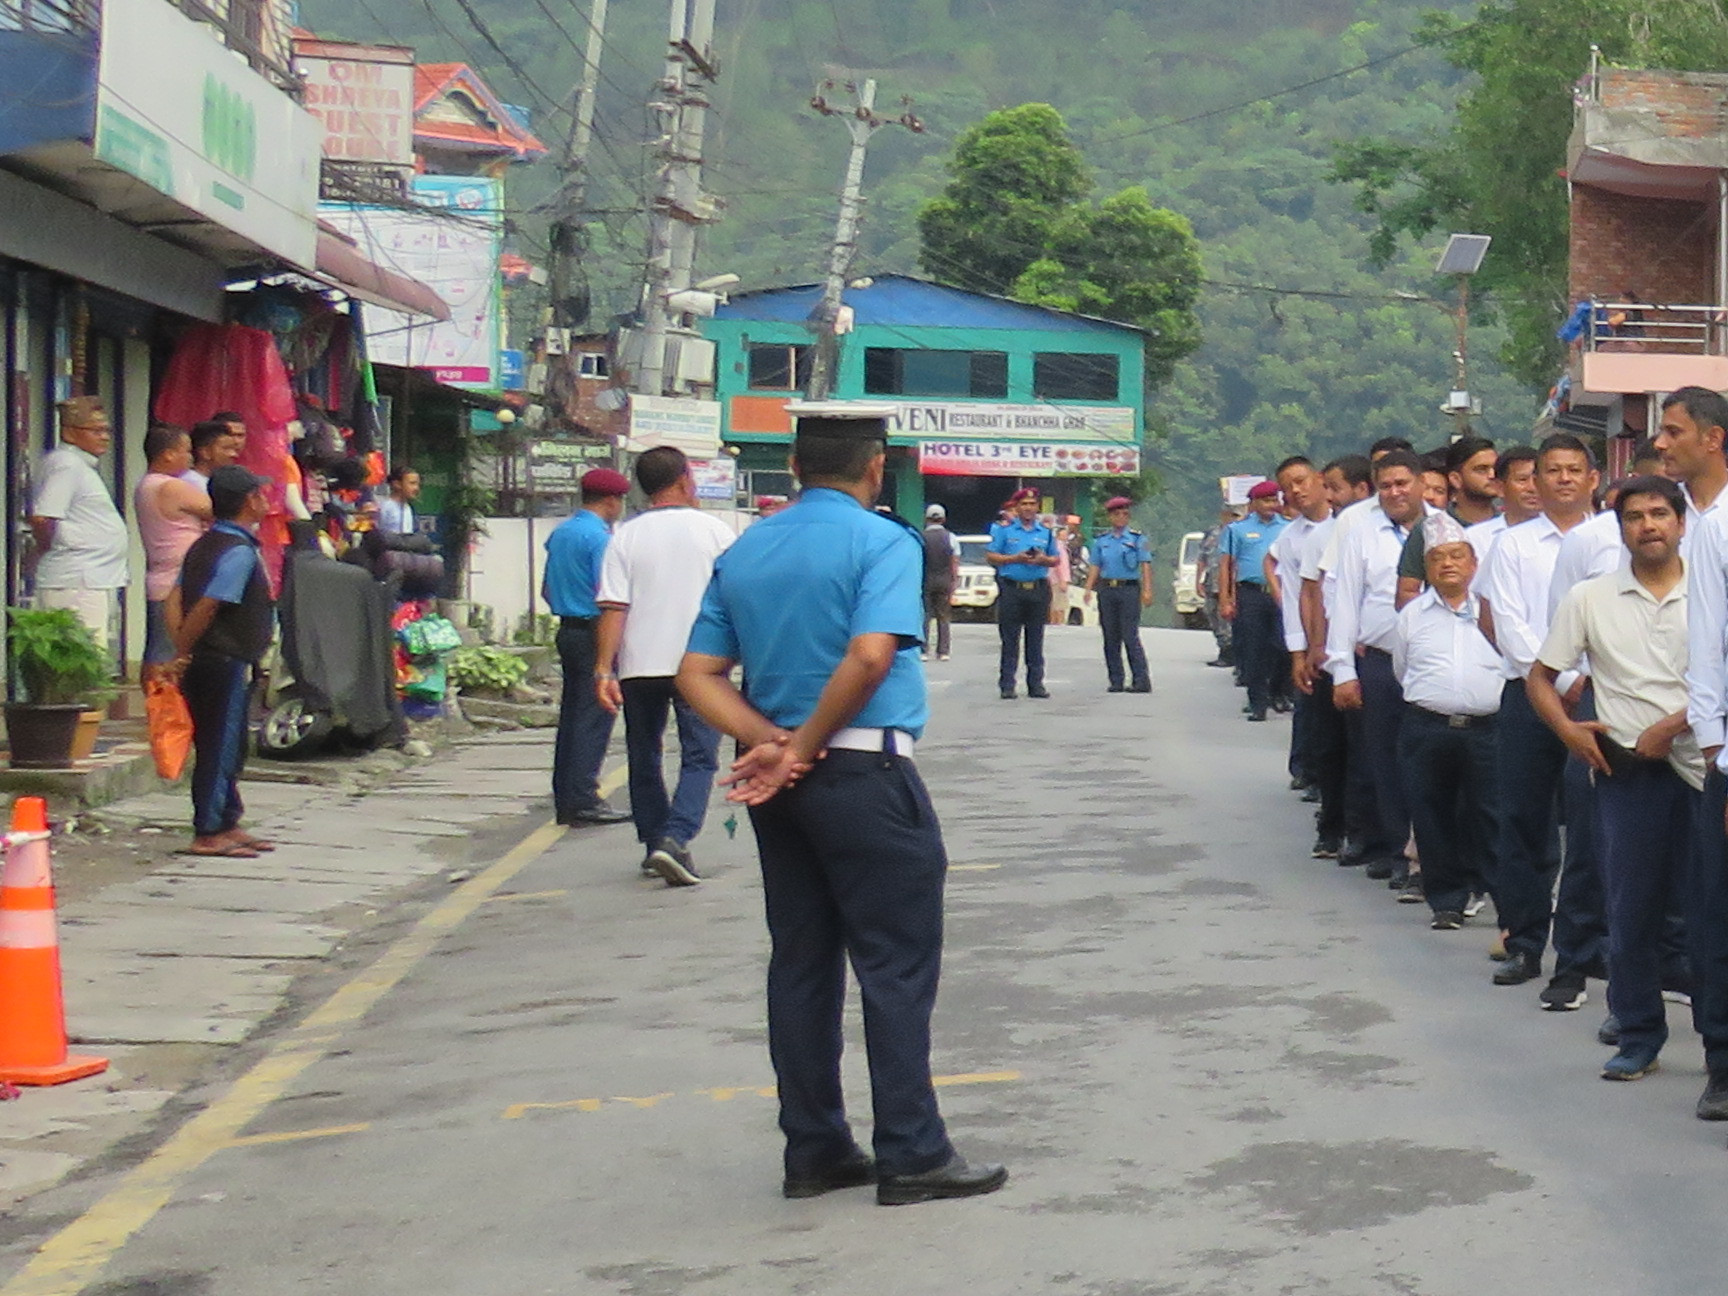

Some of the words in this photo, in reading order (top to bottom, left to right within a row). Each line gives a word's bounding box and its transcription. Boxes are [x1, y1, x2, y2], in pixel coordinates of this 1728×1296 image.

[308, 108, 401, 136] UEST
[950, 414, 1003, 427] RESTAURANT
[924, 443, 984, 457] HOTEL
[1020, 445, 1051, 459] EYE
